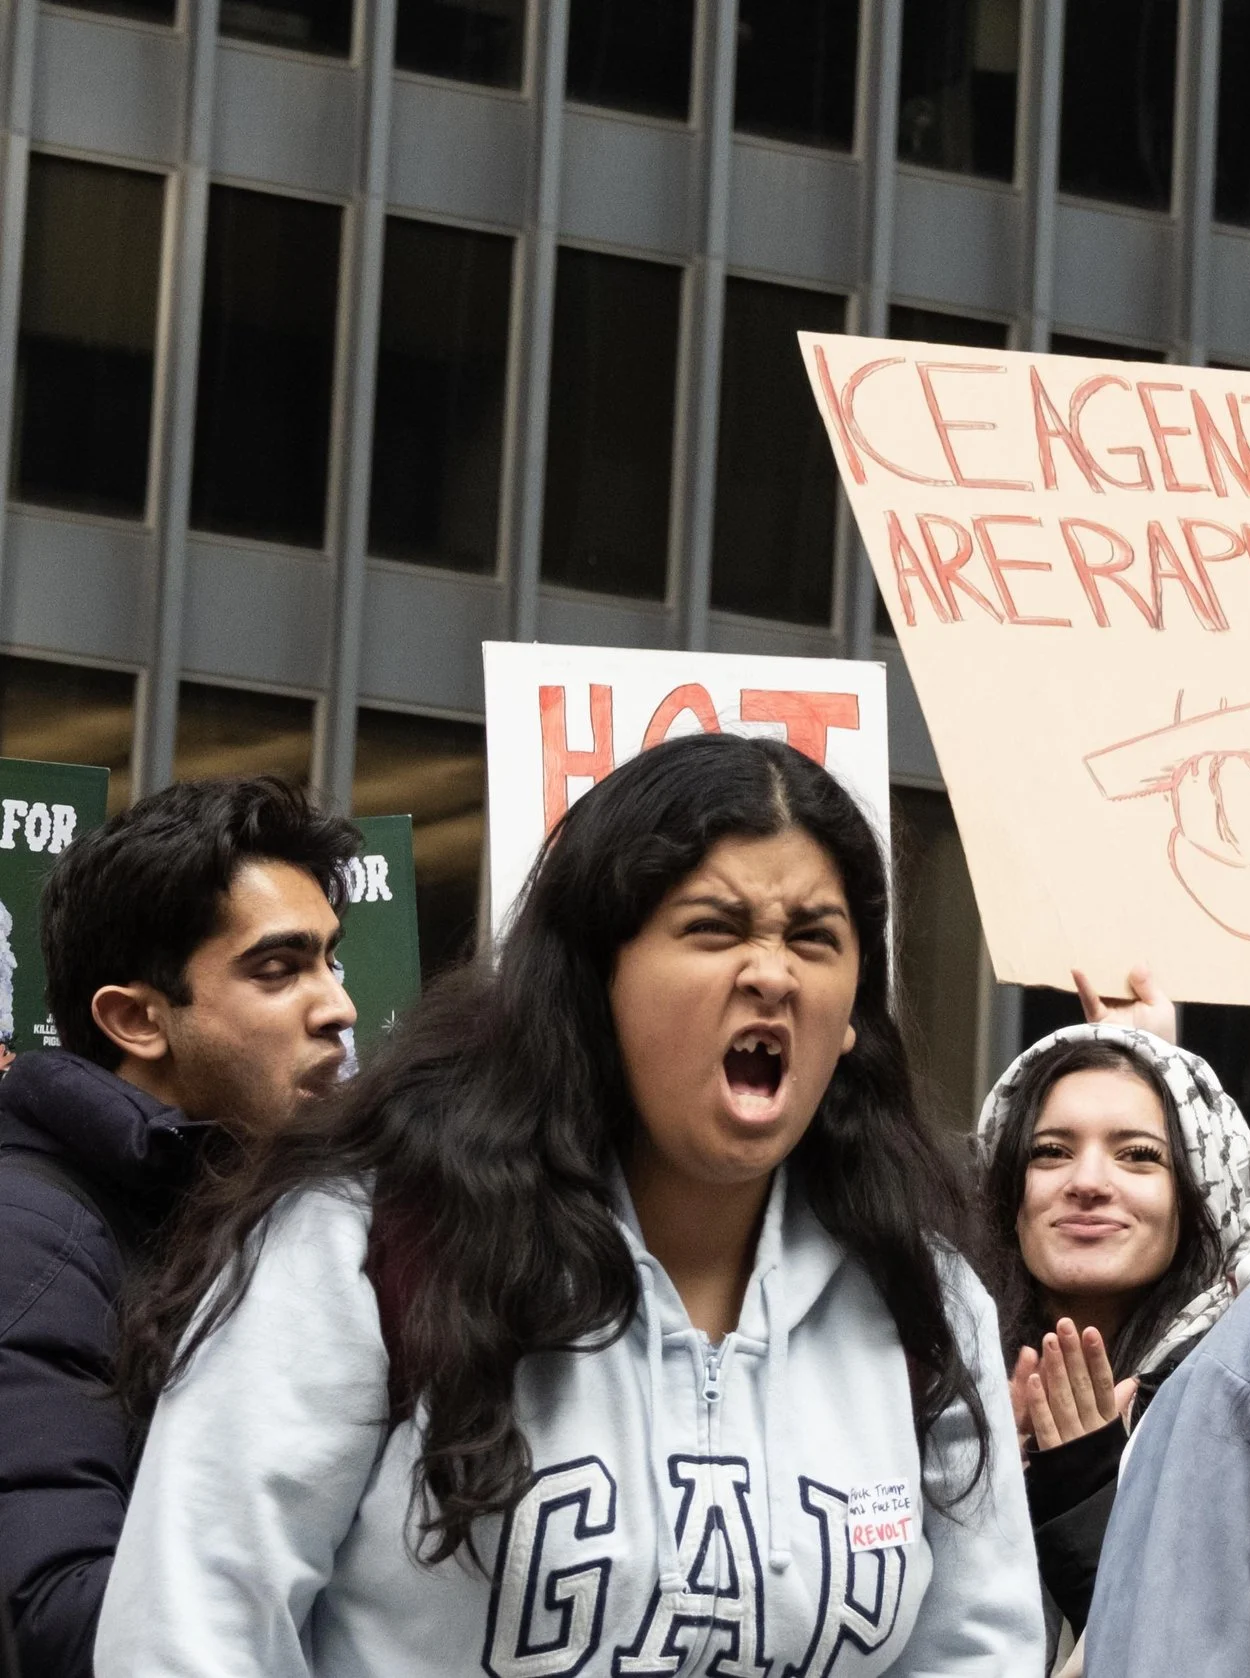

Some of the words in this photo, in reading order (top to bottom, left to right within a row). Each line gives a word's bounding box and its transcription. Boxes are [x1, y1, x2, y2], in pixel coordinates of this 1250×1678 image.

[813, 344, 1034, 492] ICE
[884, 509, 1074, 628] ARE
[0, 798, 77, 854] FOR
[332, 854, 393, 903] OR
[33, 1024, 58, 1035] KILLE
[853, 1517, 912, 1546] REVOLT
[481, 1455, 906, 1678] GAP
